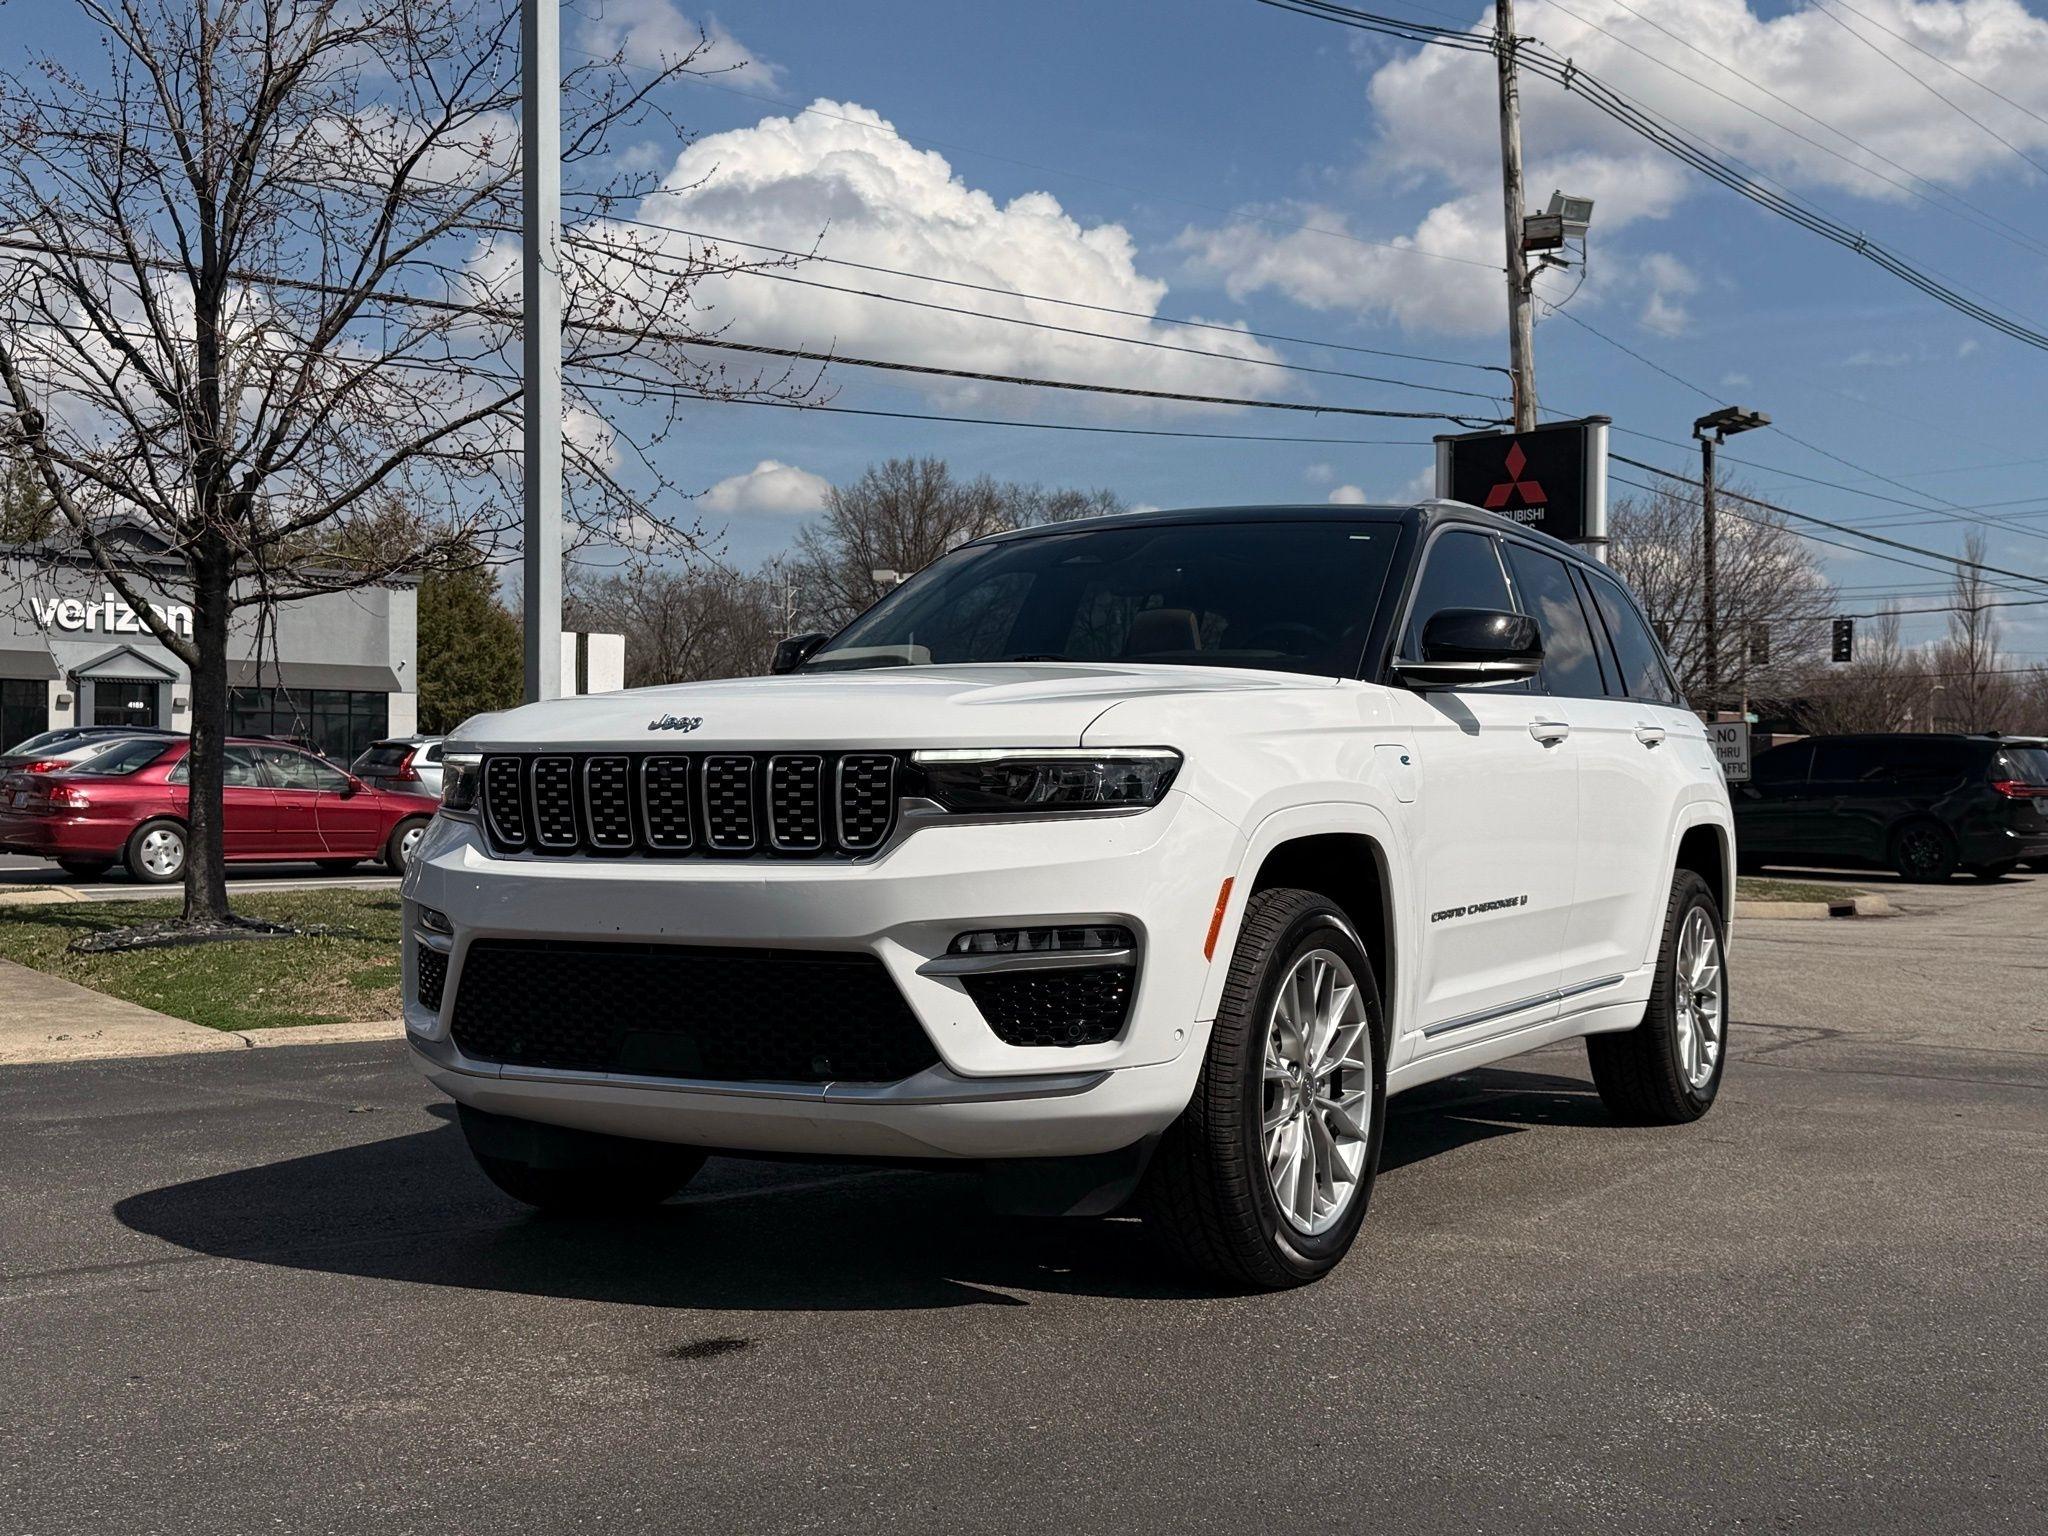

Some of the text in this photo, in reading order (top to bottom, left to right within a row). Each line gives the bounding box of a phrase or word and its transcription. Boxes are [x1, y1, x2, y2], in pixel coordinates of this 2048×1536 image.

[648, 713, 703, 733] Jeep
[1717, 728, 1736, 743] NO
[1722, 762, 1747, 775] AFFIC
[1431, 896, 1519, 923] GRAND CHEROKEE
